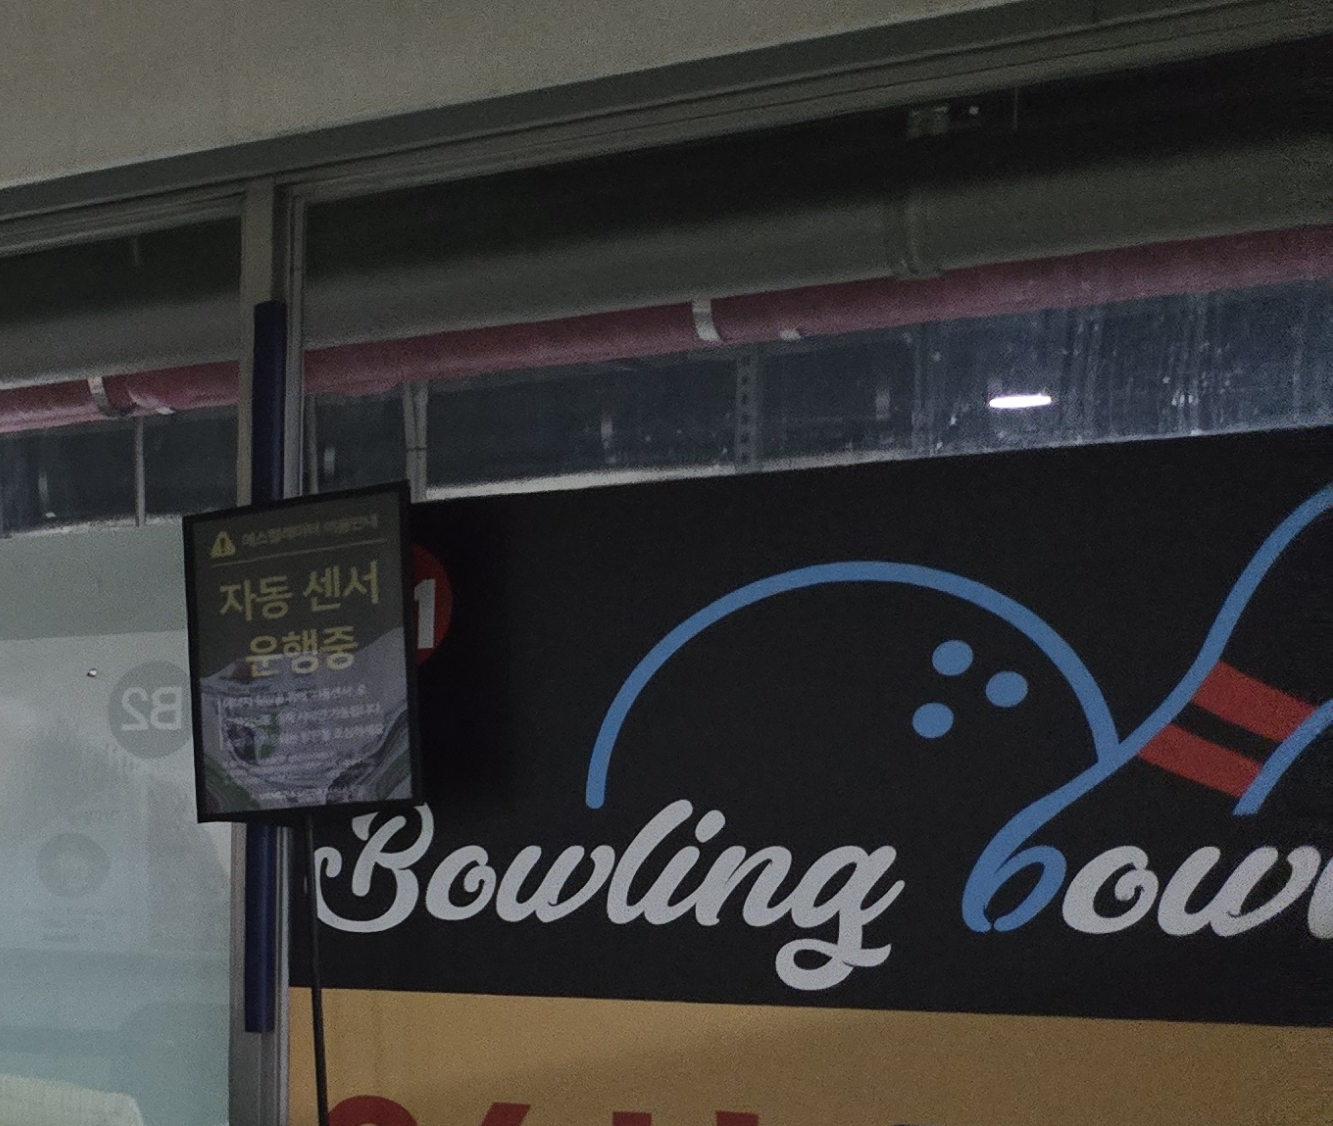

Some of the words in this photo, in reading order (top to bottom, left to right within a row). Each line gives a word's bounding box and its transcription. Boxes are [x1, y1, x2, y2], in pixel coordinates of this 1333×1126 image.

[218, 574, 293, 622] 자동
[302, 559, 380, 612] 센서
[244, 624, 359, 679] 운행중
[312, 797, 904, 991] Bowling
